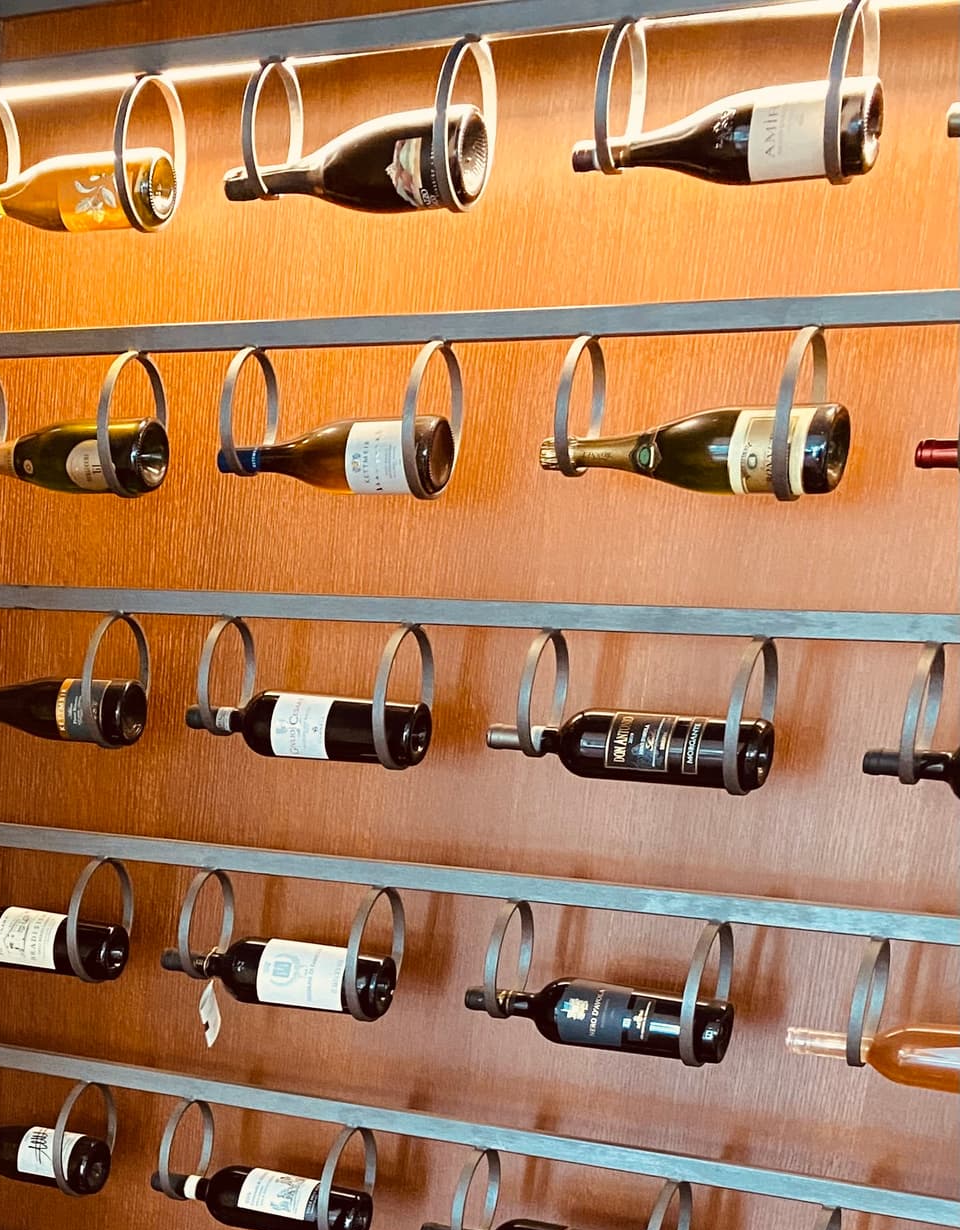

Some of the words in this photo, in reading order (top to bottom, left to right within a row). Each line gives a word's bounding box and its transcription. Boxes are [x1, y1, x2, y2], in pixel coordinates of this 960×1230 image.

[687, 723, 701, 764] MORGANTE
[614, 746, 627, 762] DON
[589, 1017, 598, 1036] NERO
